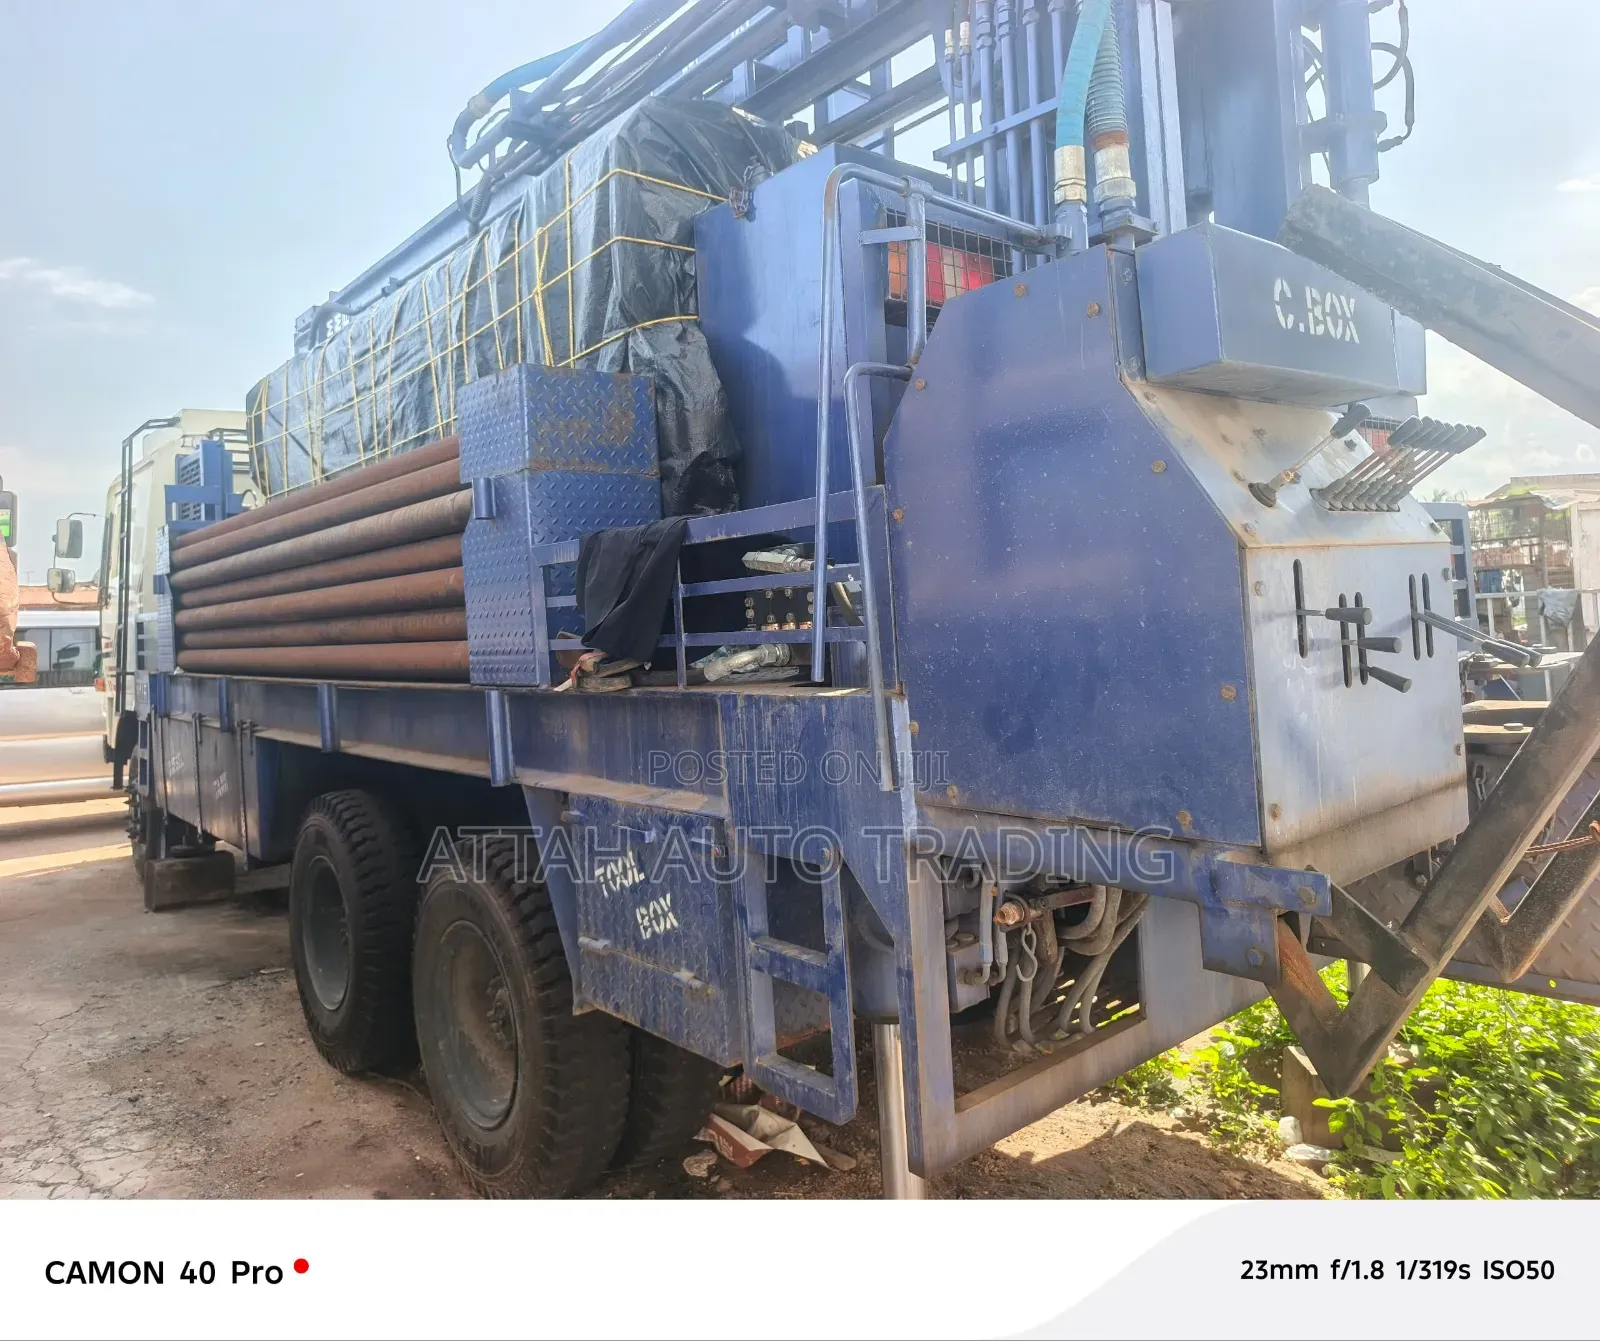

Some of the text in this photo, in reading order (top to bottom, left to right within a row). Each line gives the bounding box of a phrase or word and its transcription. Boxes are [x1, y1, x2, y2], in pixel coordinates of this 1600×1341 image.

[1273, 277, 1360, 344] C.BOX
[594, 850, 645, 898] TOOL
[635, 892, 679, 940] BOX
